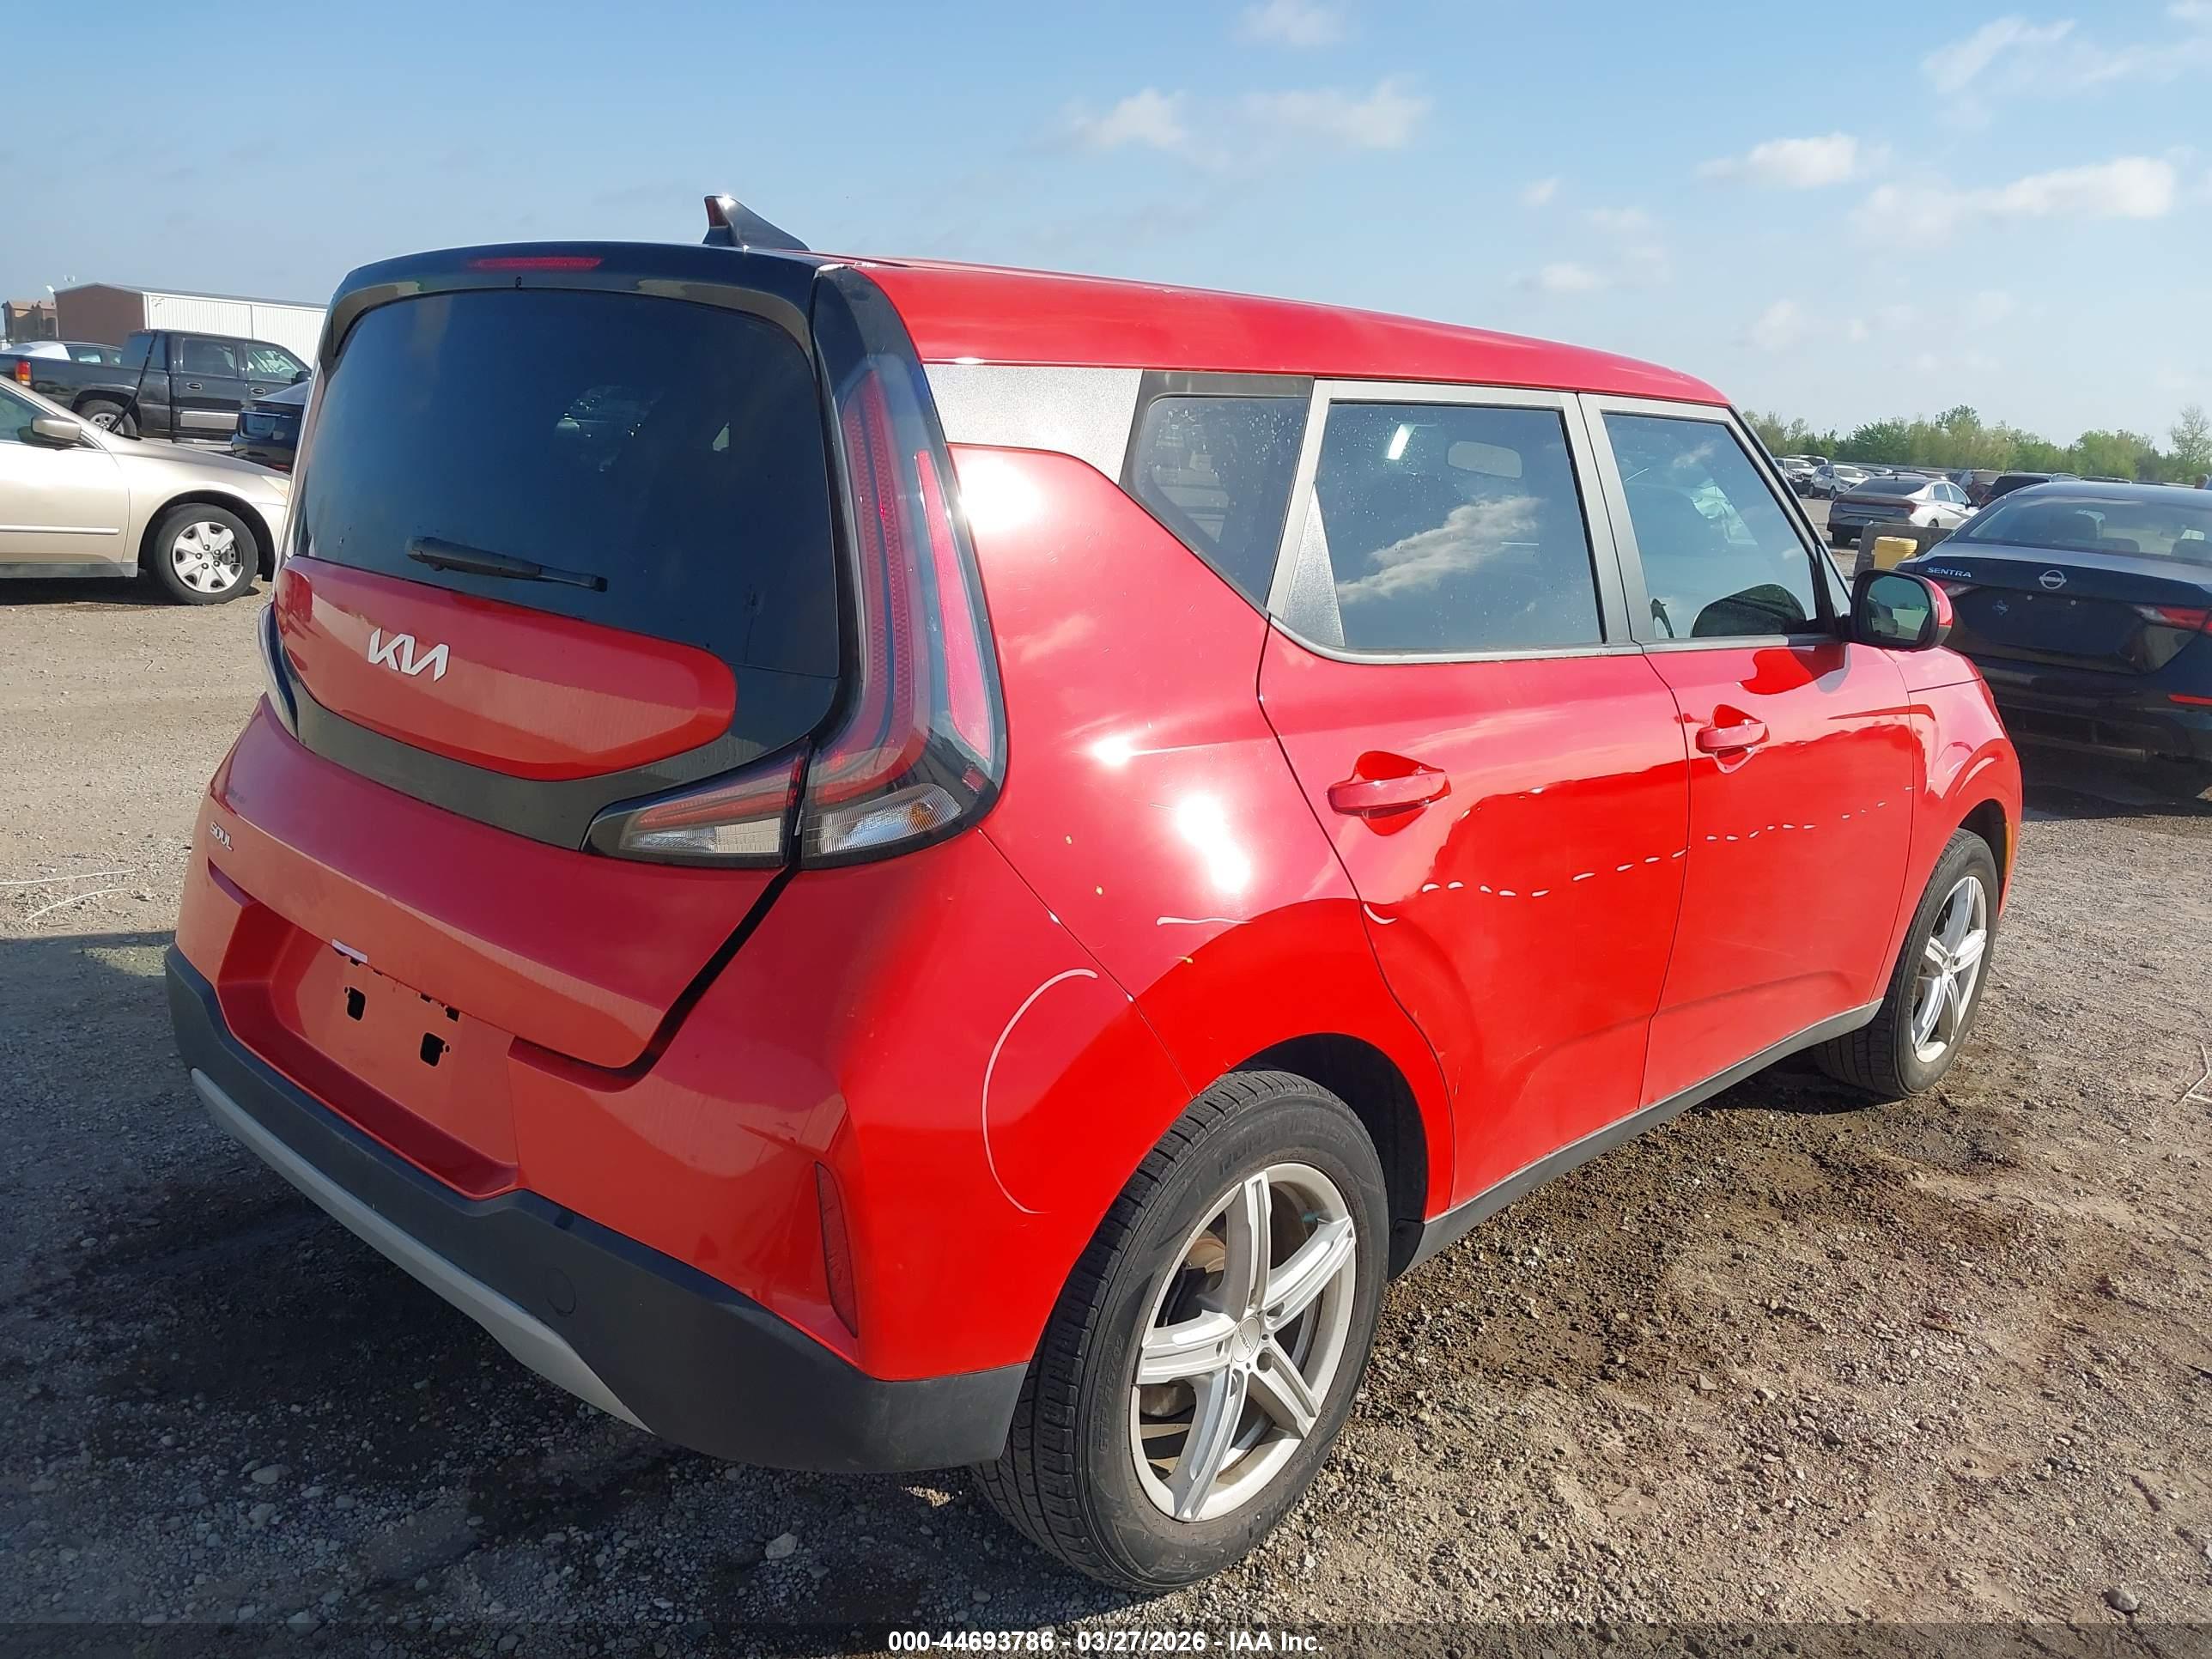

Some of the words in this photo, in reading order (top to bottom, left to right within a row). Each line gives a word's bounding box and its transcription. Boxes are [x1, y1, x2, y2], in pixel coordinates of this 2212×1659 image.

[1927, 567, 1972, 578] SENTRA
[368, 627, 450, 682] KIA
[210, 821, 234, 852] SOUL
